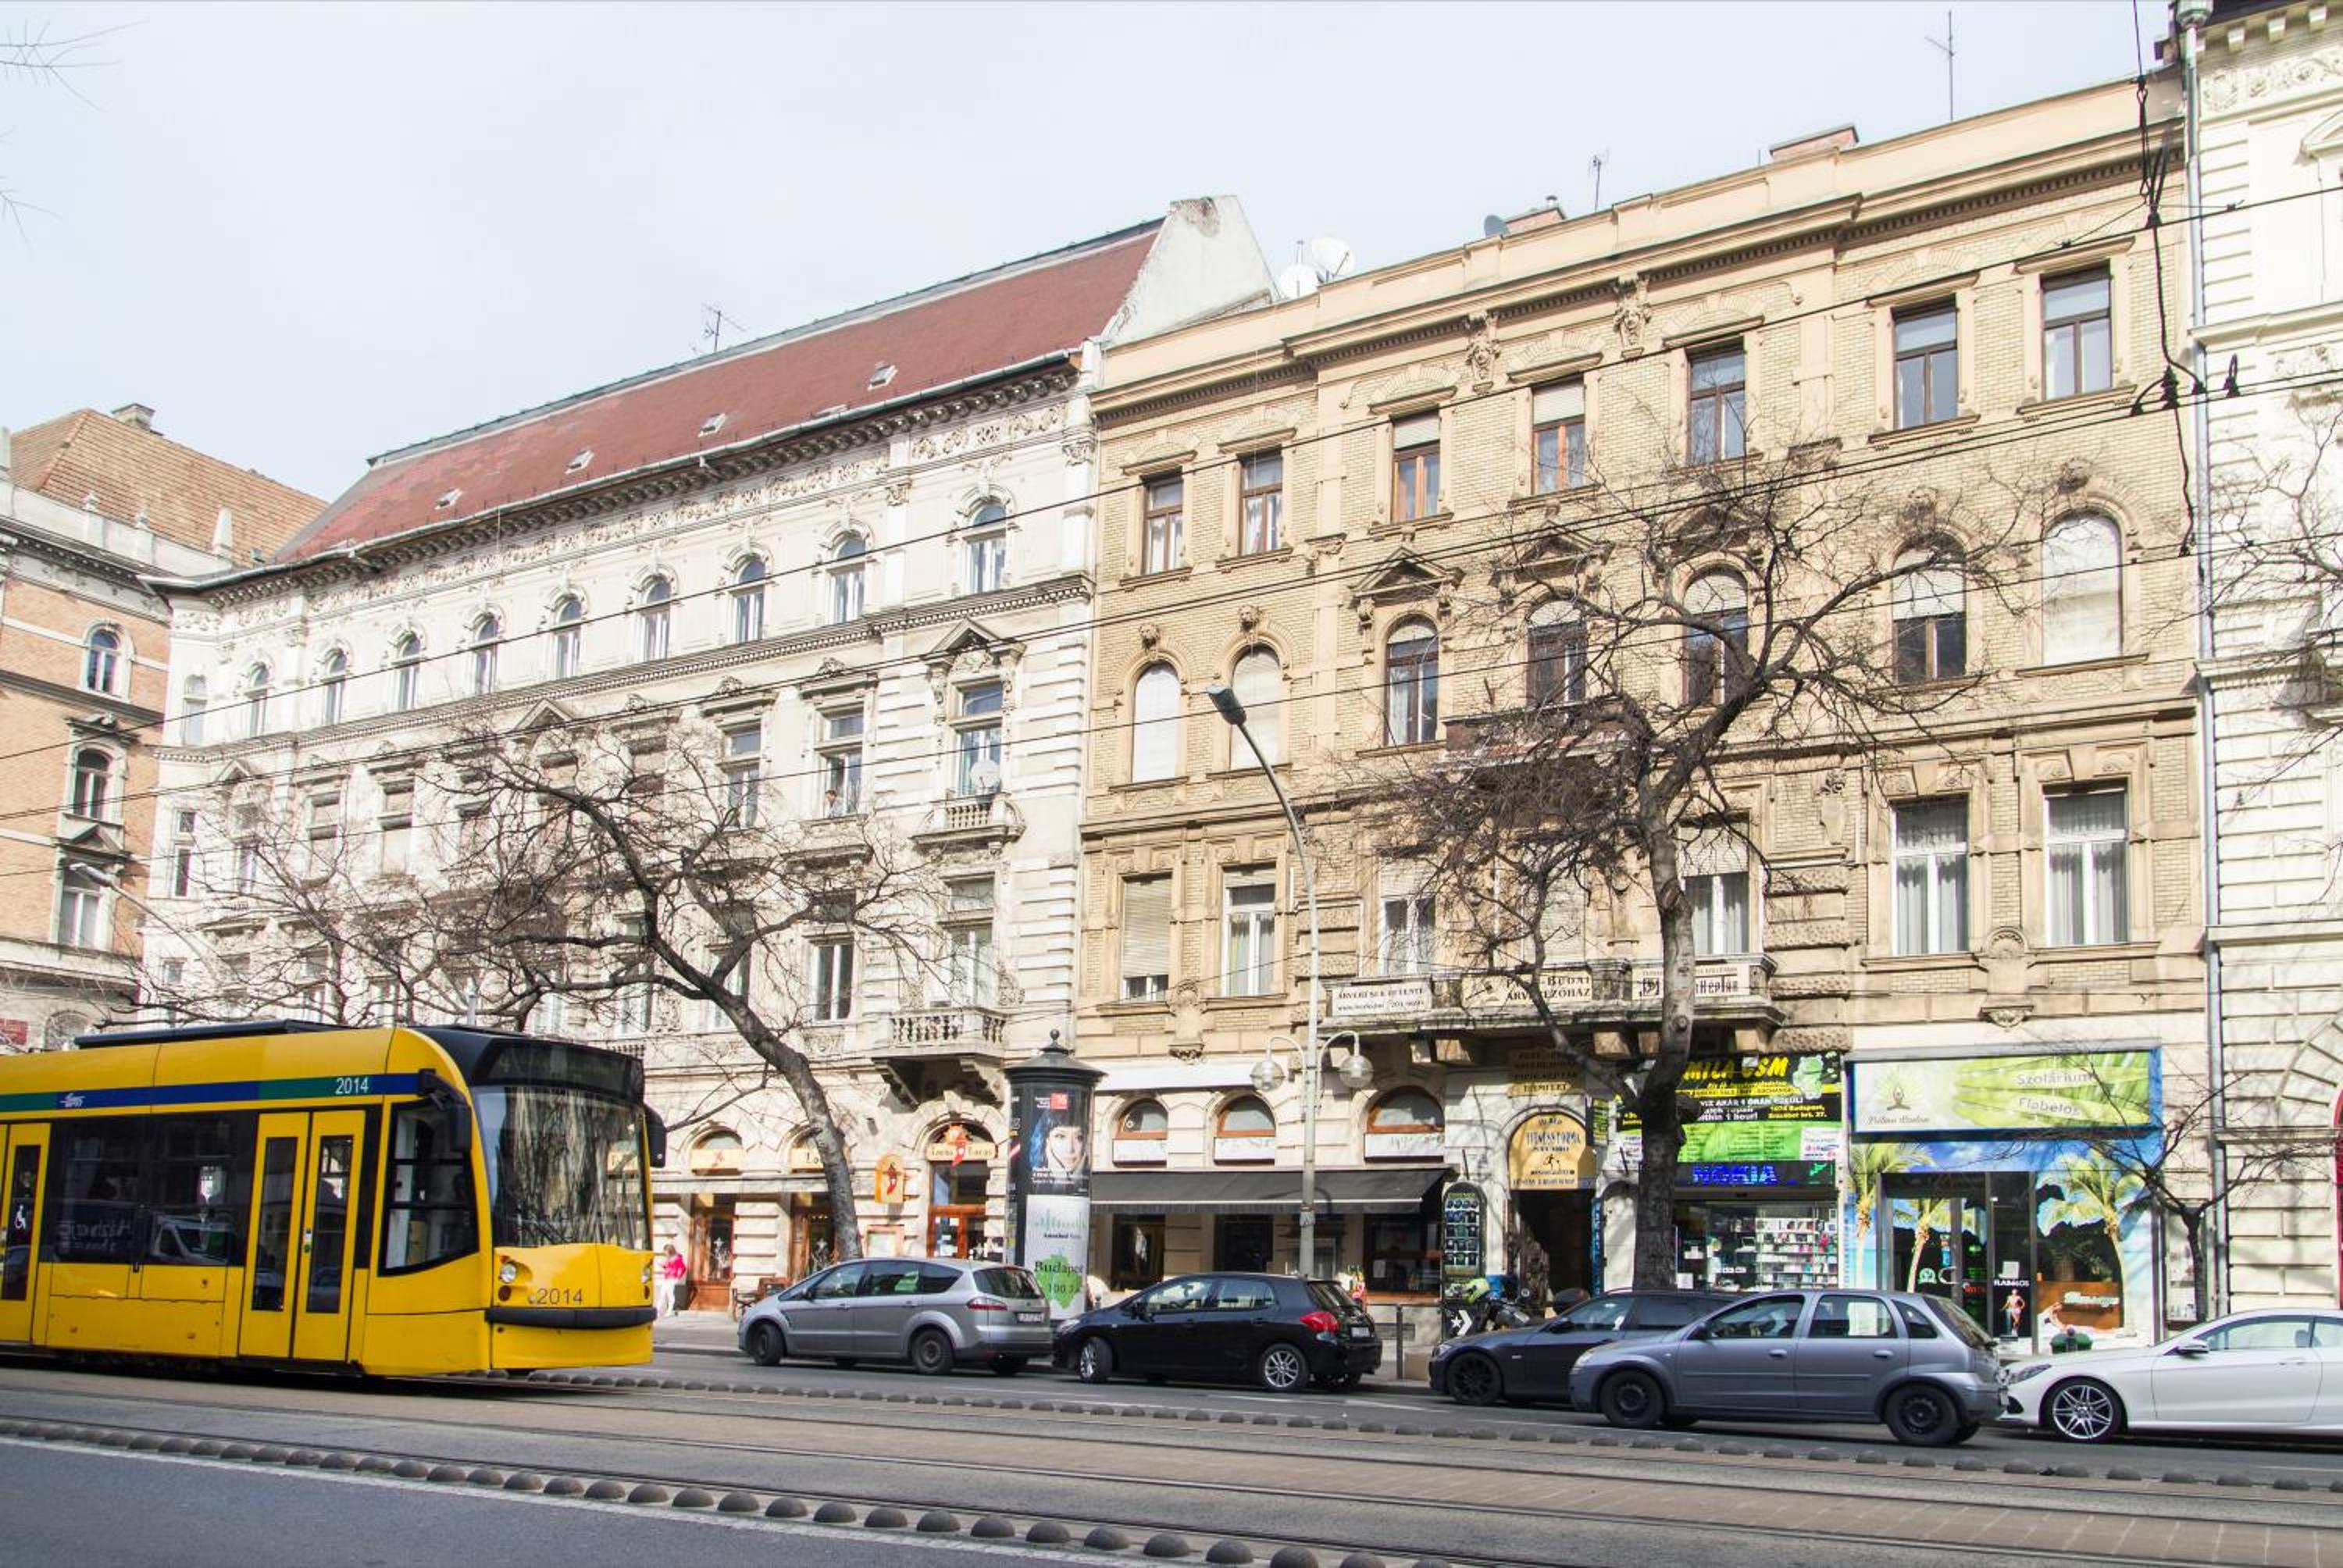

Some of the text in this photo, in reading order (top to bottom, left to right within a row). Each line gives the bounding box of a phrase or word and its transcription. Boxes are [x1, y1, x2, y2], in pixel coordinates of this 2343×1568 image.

[335, 1077, 369, 1095] 2014
[2017, 1071, 2093, 1085] Szolárium
[2019, 1097, 2081, 1116] Flabelos
[1692, 1165, 1778, 1185] NOKIA
[537, 1287, 583, 1305] 2014
